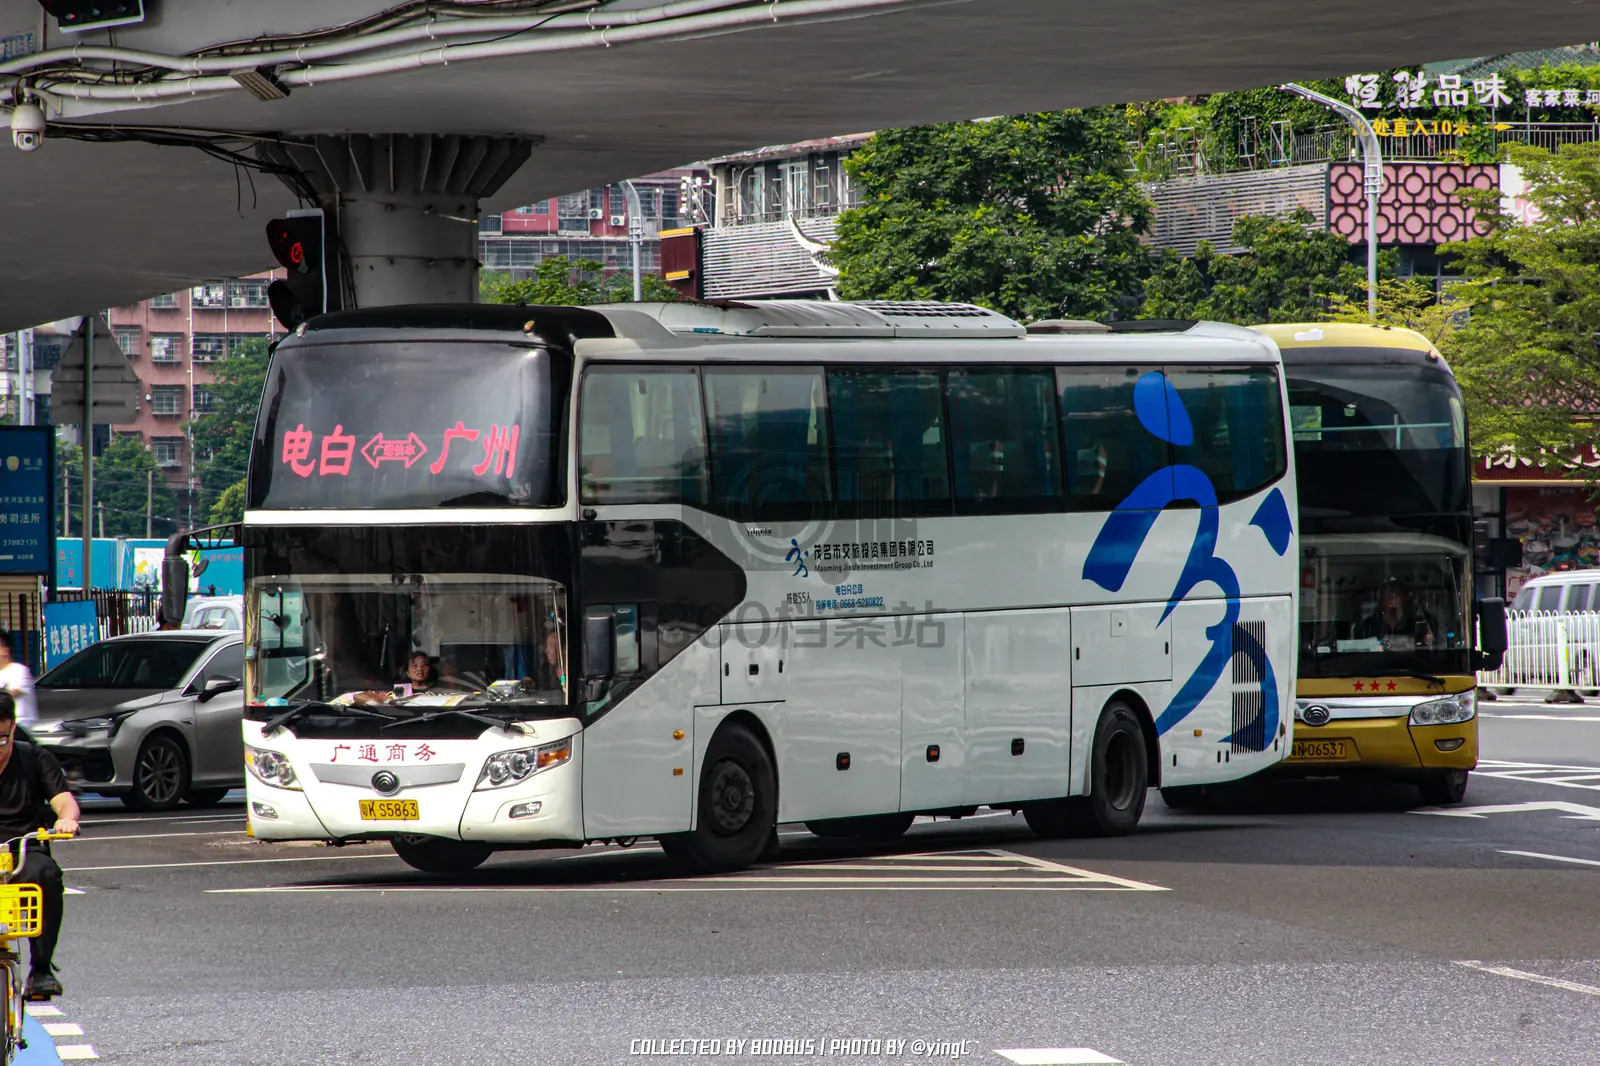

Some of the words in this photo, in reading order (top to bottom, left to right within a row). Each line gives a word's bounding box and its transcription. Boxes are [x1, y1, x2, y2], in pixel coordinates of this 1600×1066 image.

[1352, 117, 1470, 138] 处直入10米
[282, 424, 356, 478] 电白
[429, 421, 519, 479] 广州
[813, 540, 935, 561] 茂名市交旅投资集团有限公司
[814, 563, 842, 573] Maoming
[894, 561, 913, 570] Group
[330, 743, 437, 763] 广通商务
